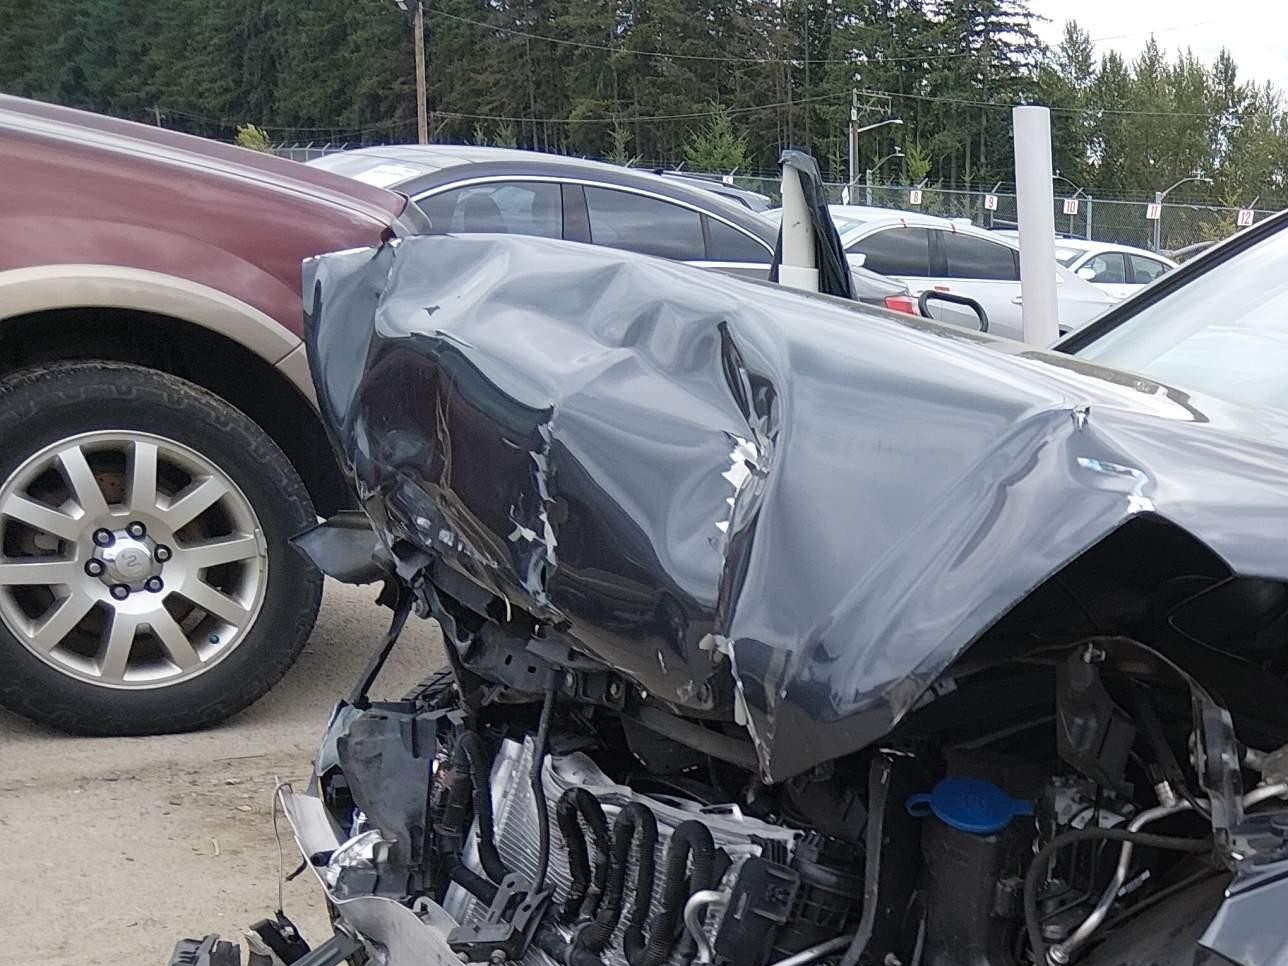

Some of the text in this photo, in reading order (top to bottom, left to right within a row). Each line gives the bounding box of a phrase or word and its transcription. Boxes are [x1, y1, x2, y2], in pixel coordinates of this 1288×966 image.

[913, 192, 919, 203] 8
[988, 196, 994, 208] 9
[1066, 200, 1076, 213] 10
[1150, 205, 1158, 218] 11
[1240, 211, 1251, 225] 12
